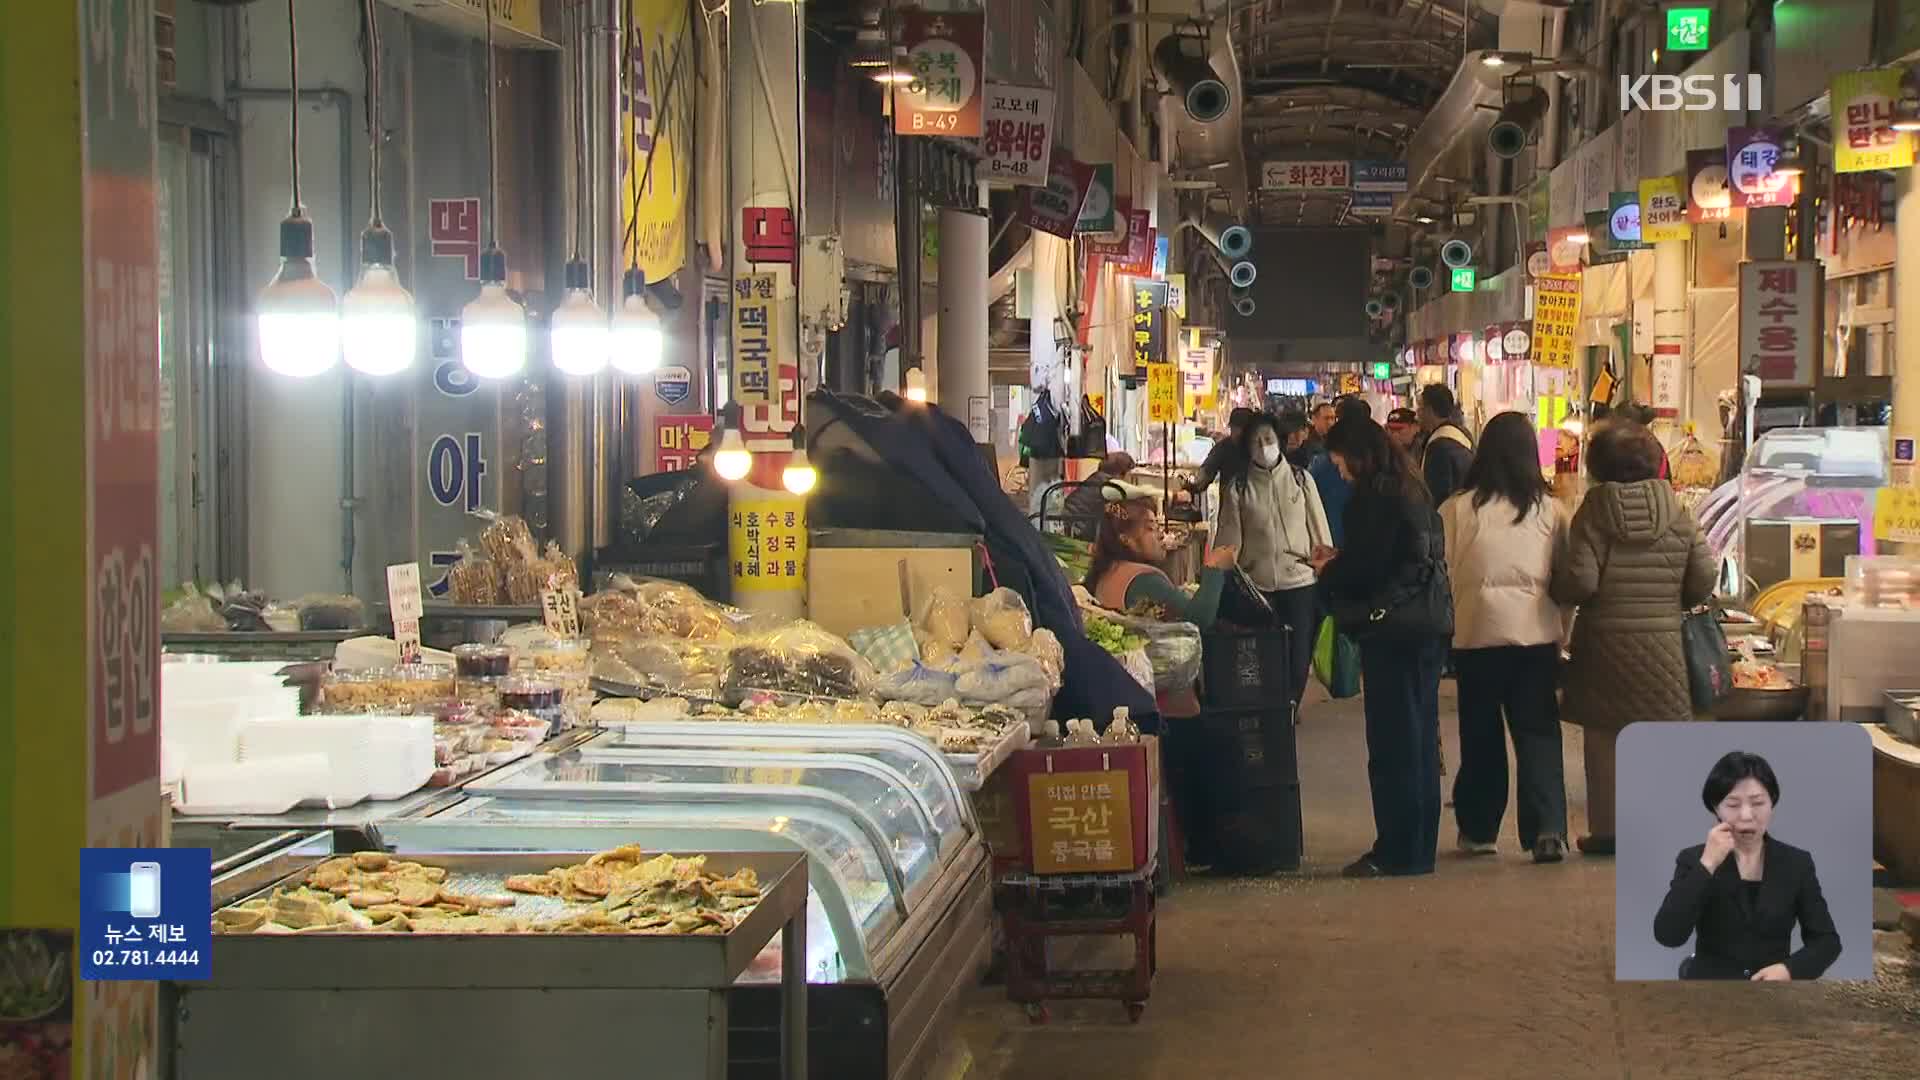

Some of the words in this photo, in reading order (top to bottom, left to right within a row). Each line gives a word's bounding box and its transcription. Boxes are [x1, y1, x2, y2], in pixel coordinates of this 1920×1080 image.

[911, 114, 957, 130] B-49
[991, 97, 1039, 115] 고모네
[984, 119, 1046, 161] 정육식당
[991, 160, 1028, 174] B-48
[1289, 164, 1347, 187] 화장실
[739, 305, 771, 400] 떡국떡
[1184, 350, 1208, 390] 두부
[746, 511, 760, 577] 호박식혜
[766, 511, 780, 577] 수정과
[97, 545, 153, 742] 할인
[1047, 801, 1113, 837] 국산
